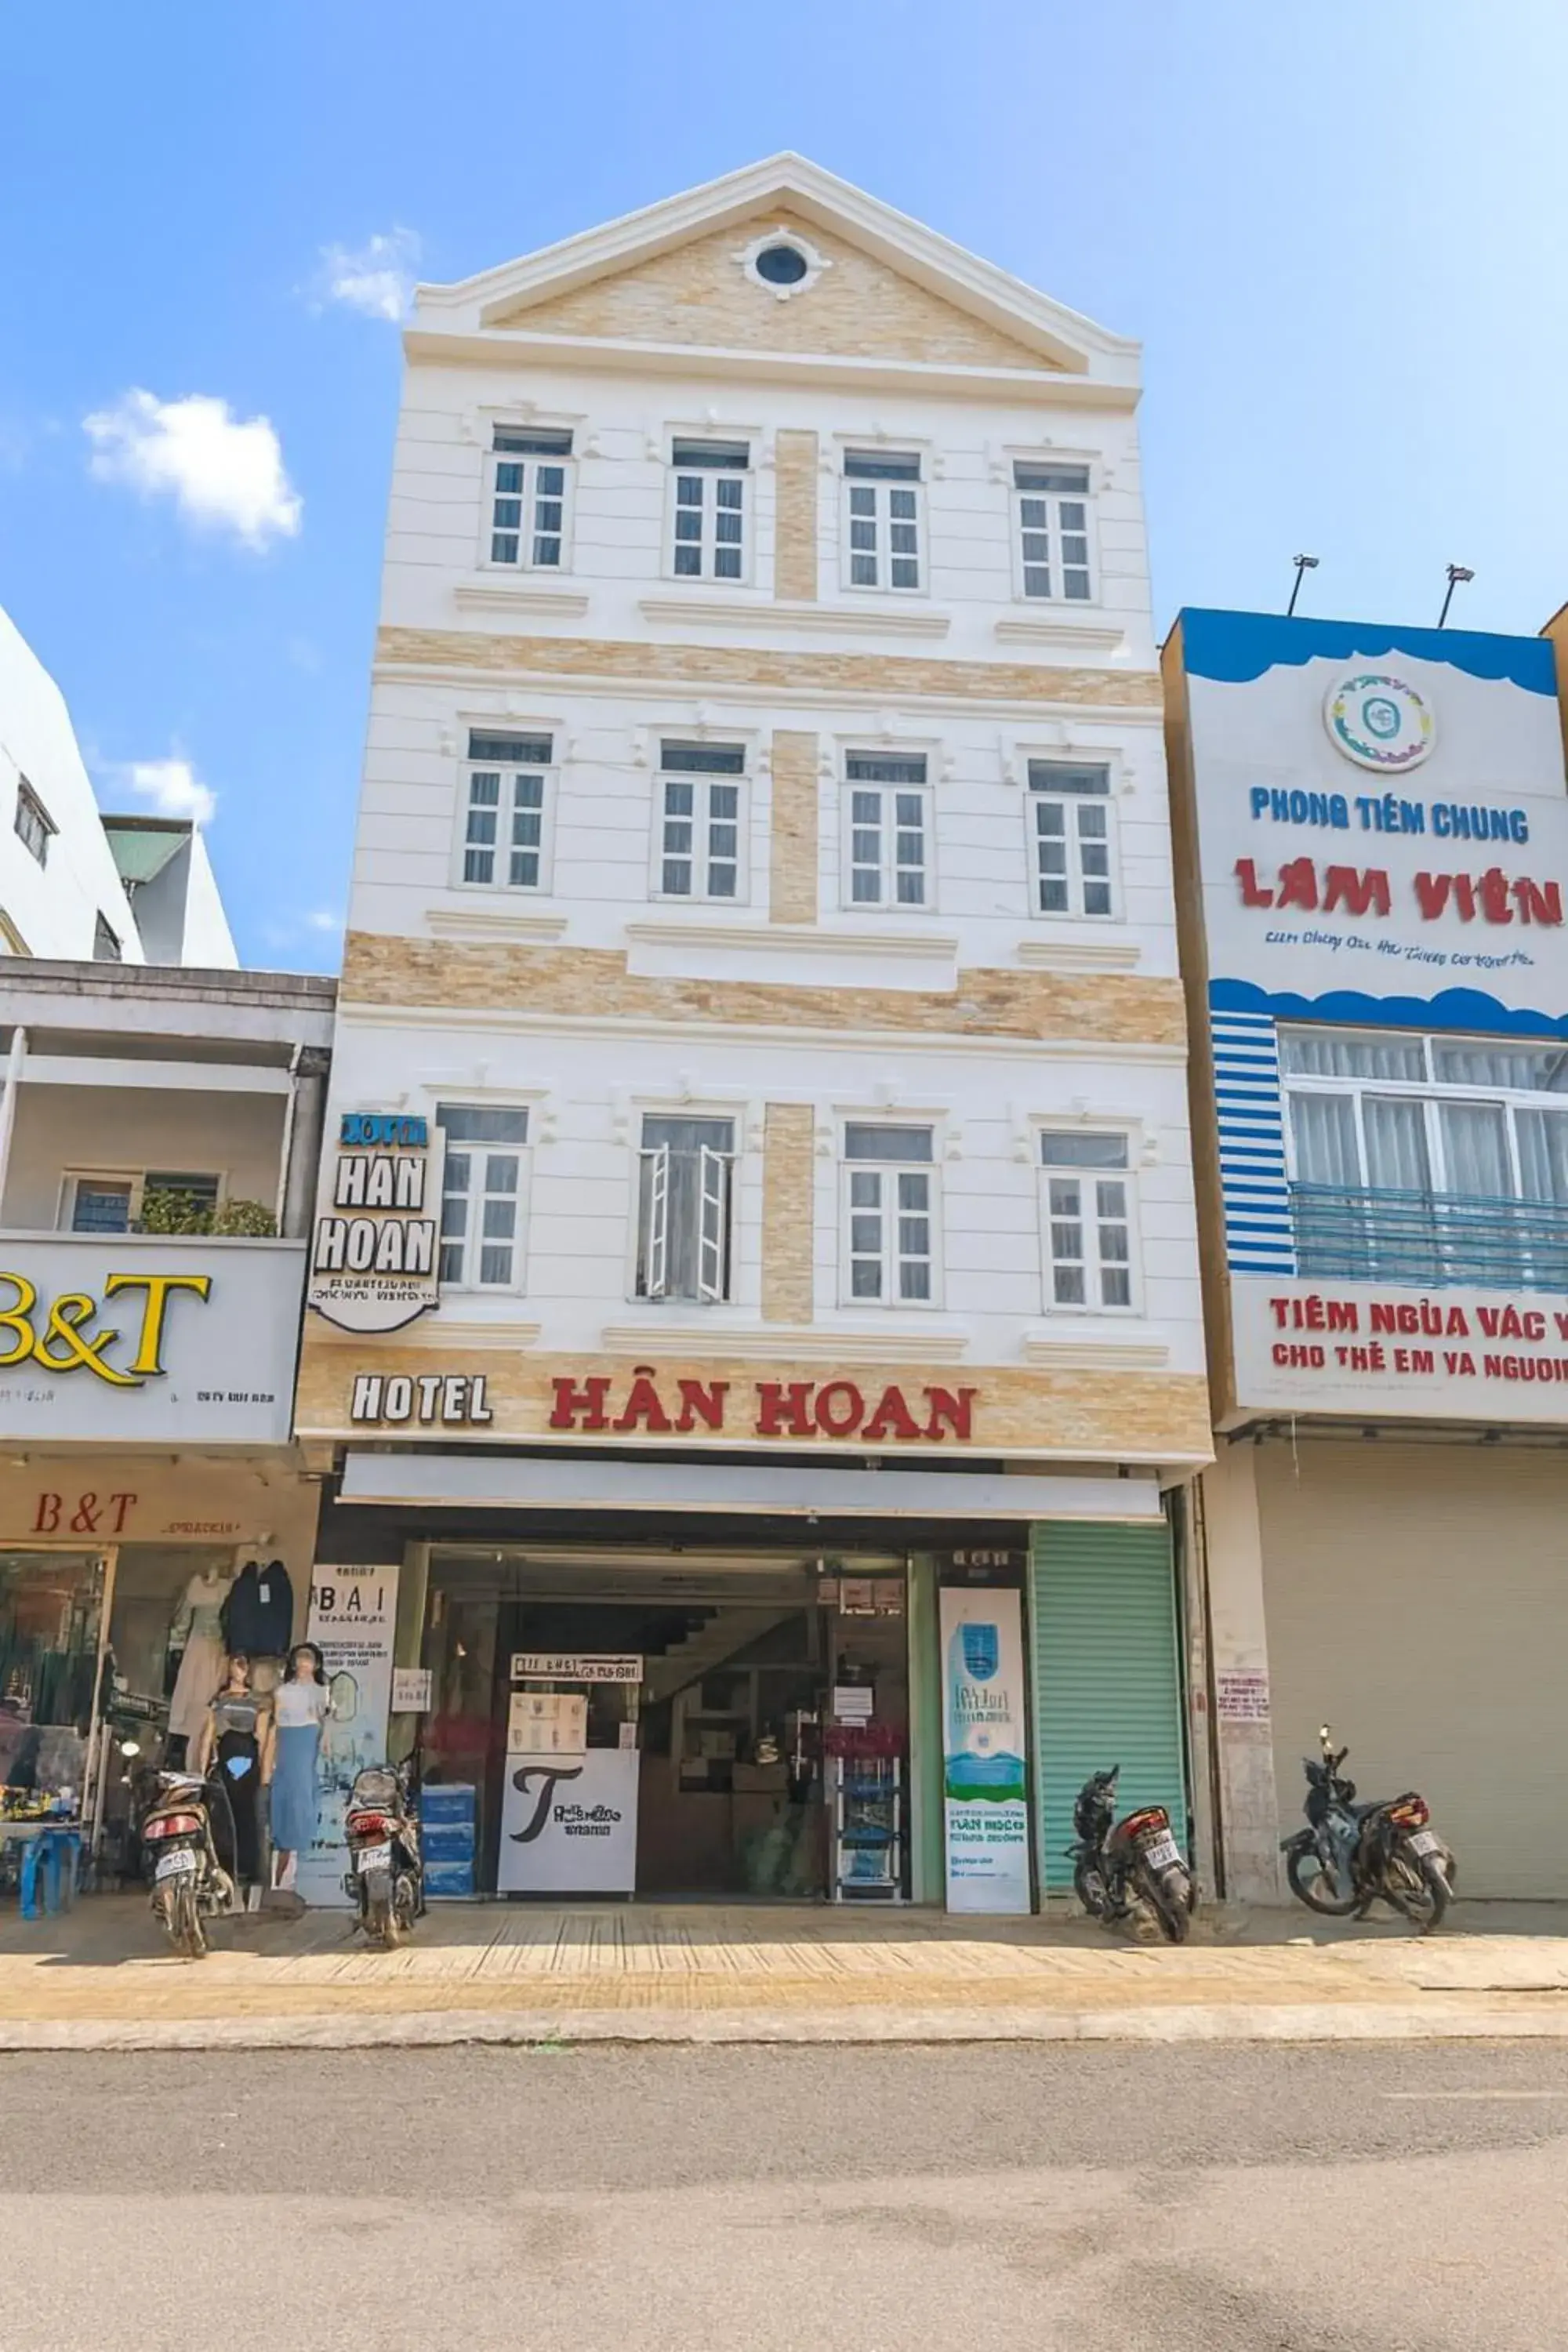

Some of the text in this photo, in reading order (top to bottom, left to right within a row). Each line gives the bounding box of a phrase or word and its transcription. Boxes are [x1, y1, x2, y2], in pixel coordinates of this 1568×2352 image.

[316, 1218, 435, 1276] HOAN
[1272, 1343, 1325, 1369] CHO
[1394, 1349, 1435, 1374] EM
[351, 1375, 492, 1424] HOTEL
[755, 1380, 977, 1439] HOAN
